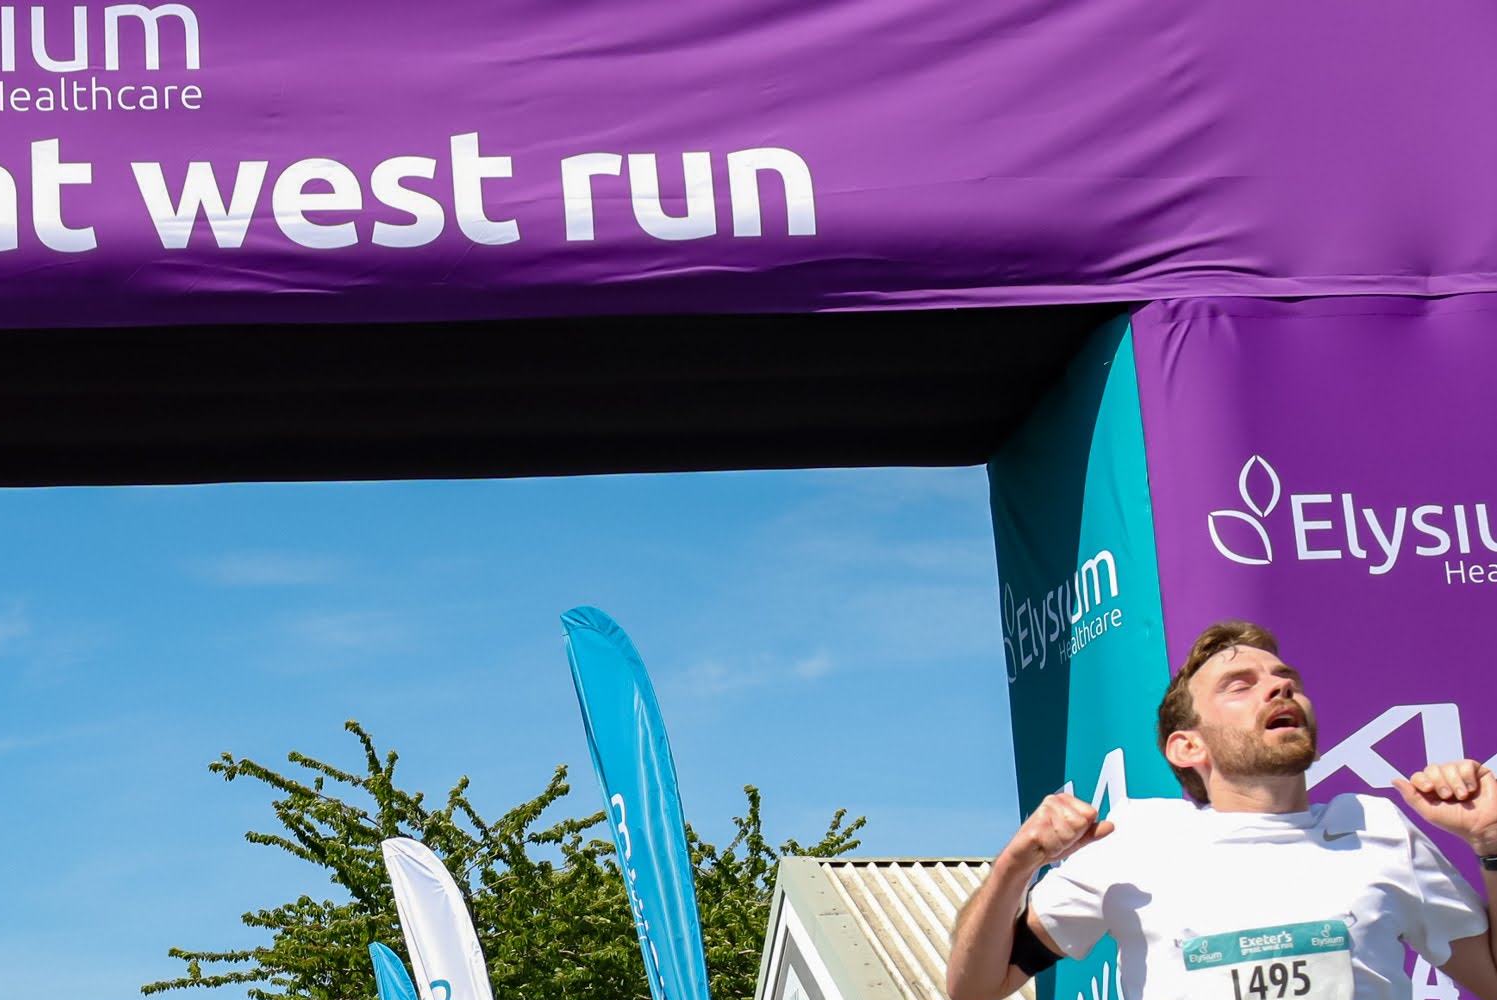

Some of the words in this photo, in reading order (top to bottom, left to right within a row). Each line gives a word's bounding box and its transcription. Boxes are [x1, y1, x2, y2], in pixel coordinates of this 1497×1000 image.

[130, 131, 514, 251] west
[560, 145, 819, 244] run
[1016, 550, 1119, 670] Elysium
[1058, 608, 1123, 665] Healthcare
[1238, 931, 1294, 949] Exeter's
